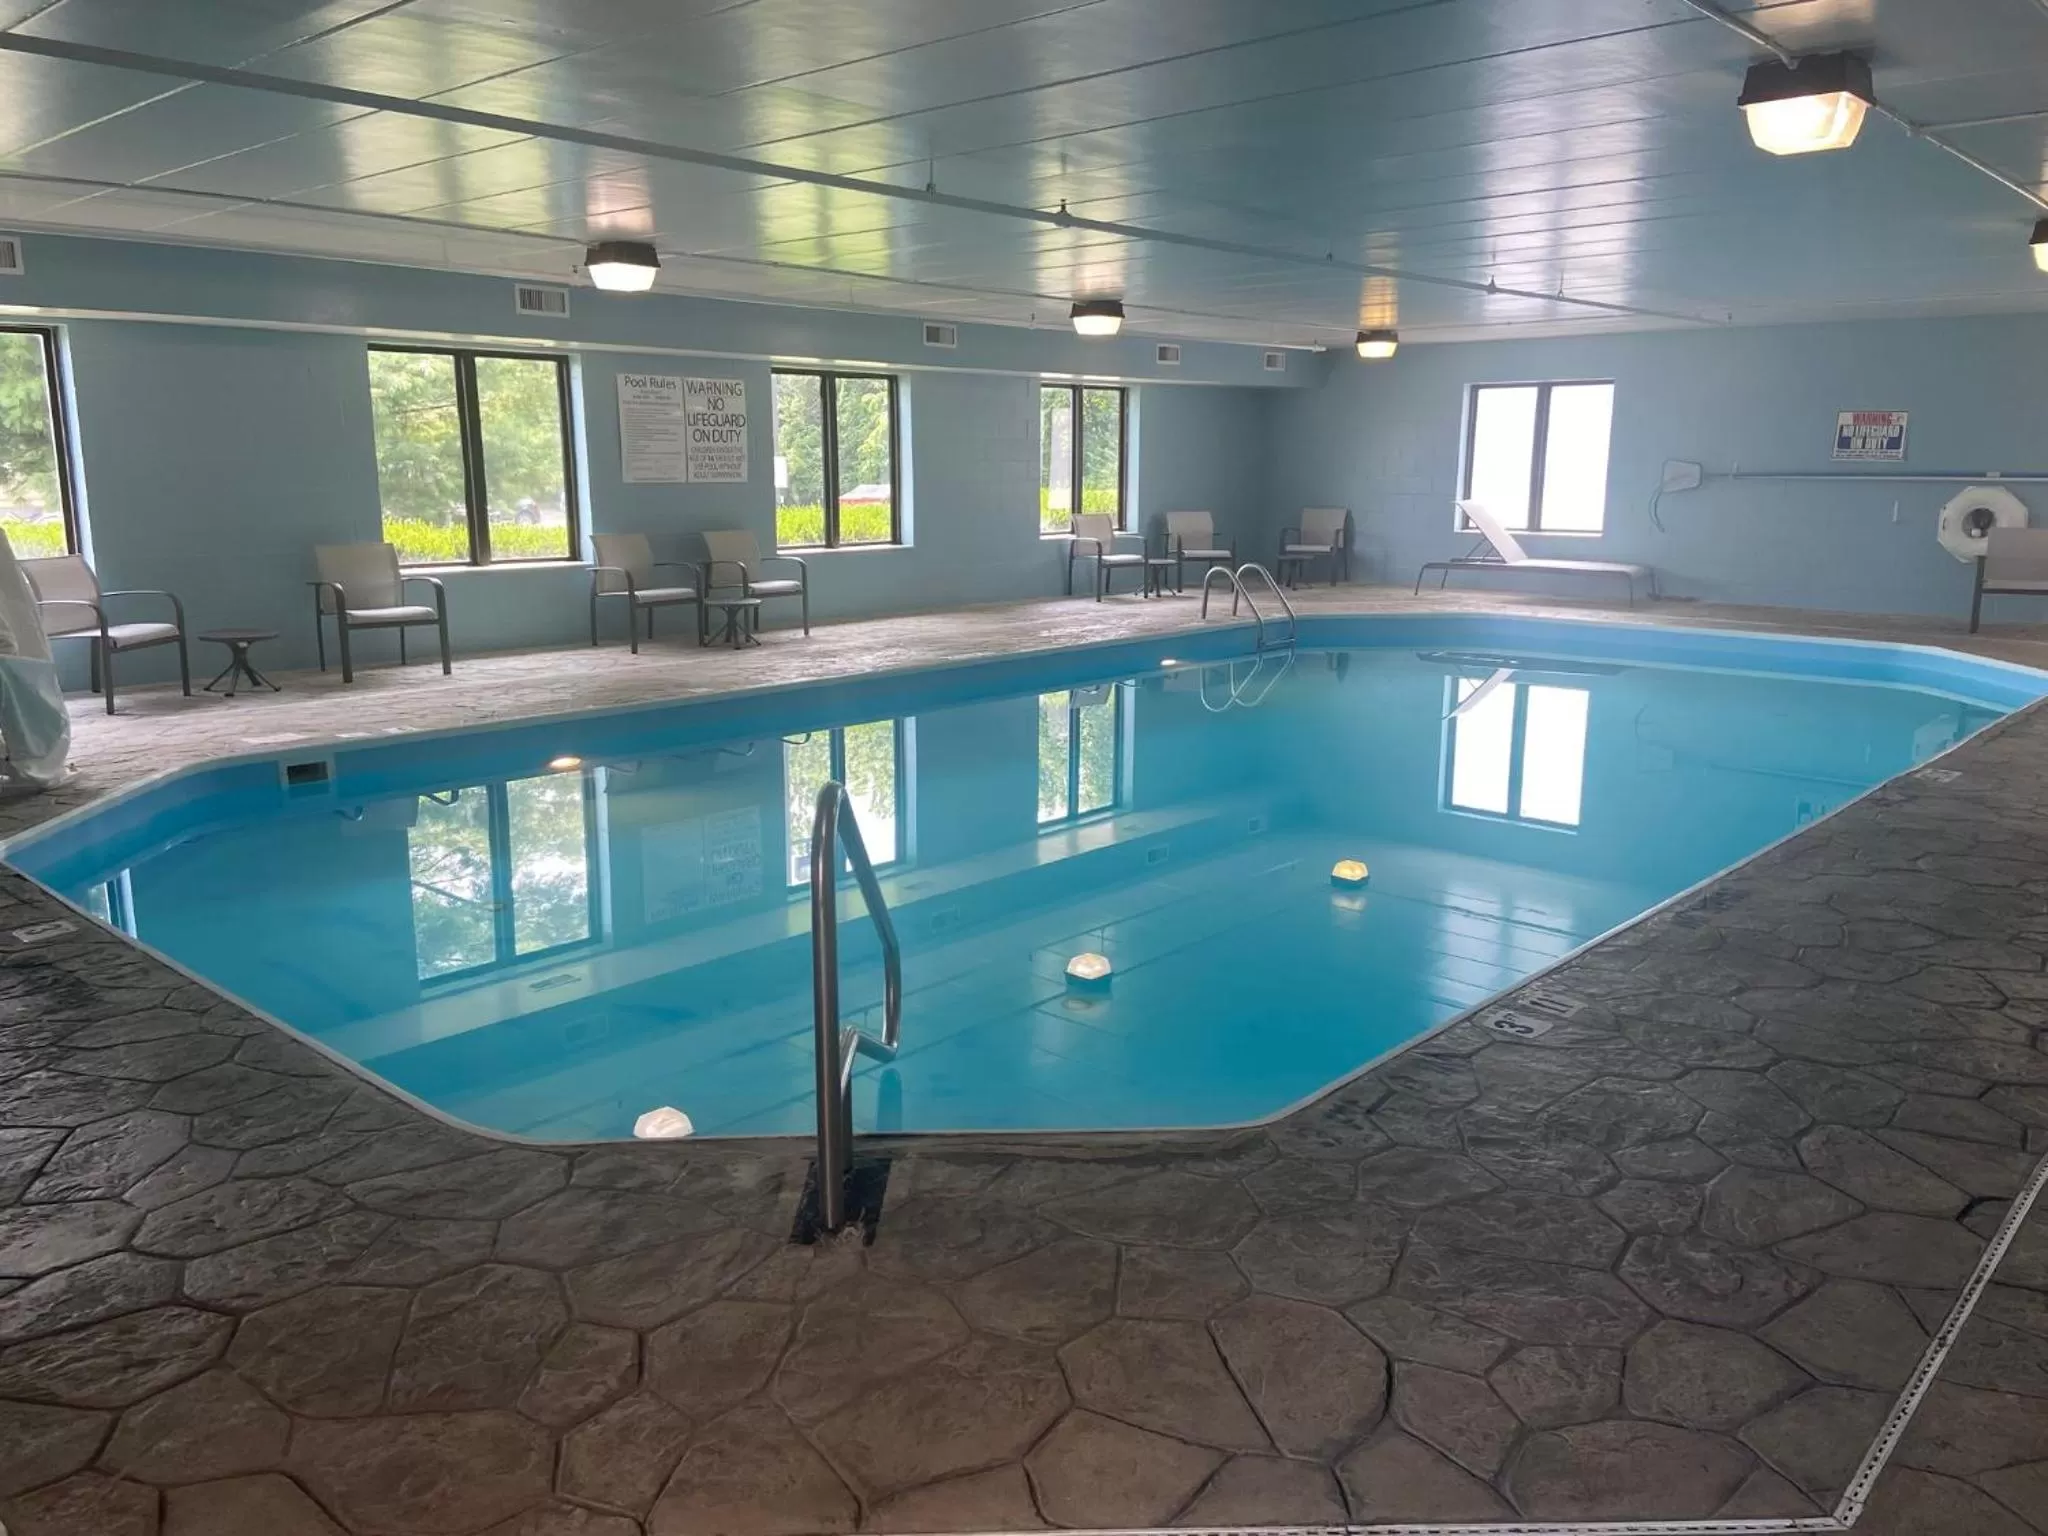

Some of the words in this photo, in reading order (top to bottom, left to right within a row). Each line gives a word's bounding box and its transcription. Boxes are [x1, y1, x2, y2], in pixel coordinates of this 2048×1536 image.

[624, 375, 647, 388] Pool
[650, 377, 676, 389] Rules
[686, 380, 742, 396] WARNING
[708, 398, 724, 411] NO
[688, 413, 746, 427] LIFEGUARD
[693, 429, 710, 442] ON
[712, 430, 741, 443] DUTY
[1494, 1020, 1534, 1034] 3
